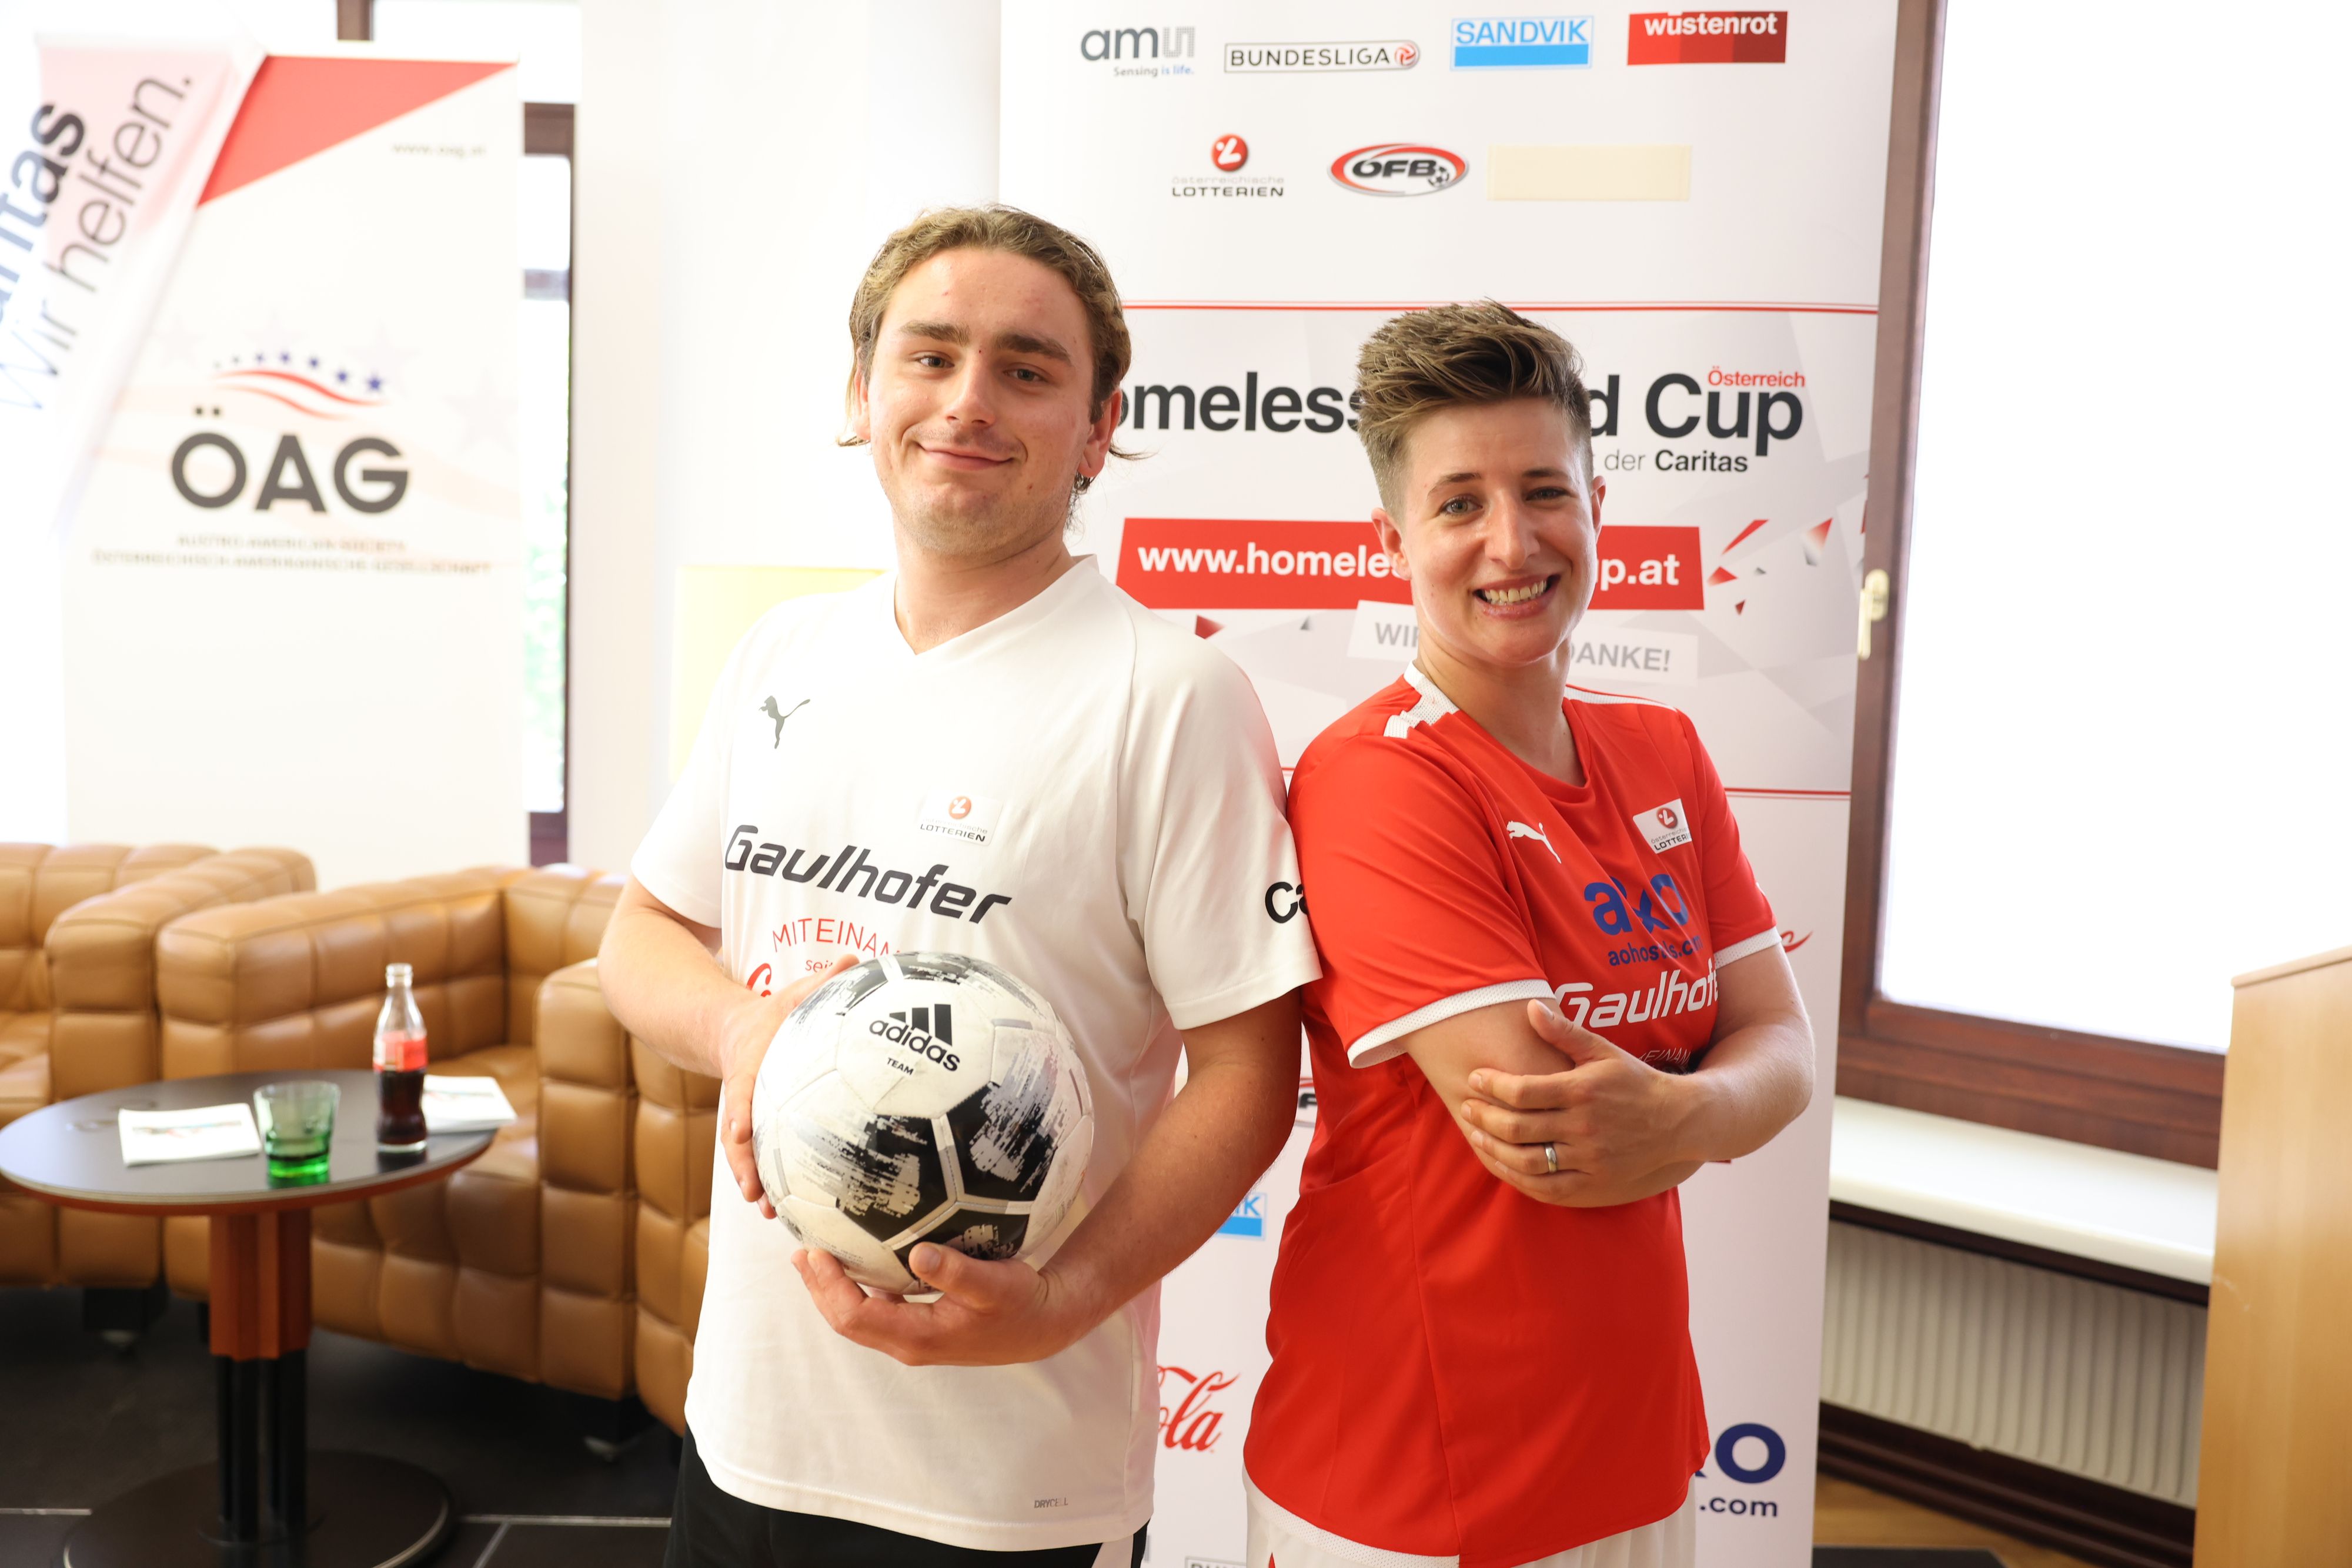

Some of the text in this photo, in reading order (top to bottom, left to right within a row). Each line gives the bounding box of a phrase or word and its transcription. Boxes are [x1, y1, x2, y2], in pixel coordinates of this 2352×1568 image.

[1455, 19, 1588, 45] SANDVIK
[1231, 48, 1390, 66] BUNDESLIGA
[1114, 66, 1158, 77] Sensing
[1162, 65, 1170, 75] is
[43, 74, 193, 293] helfen.
[1172, 186, 1284, 197] LOTTERIEN
[1708, 366, 1805, 389] Österreich
[1120, 372, 1362, 433] meles
[1646, 373, 1803, 456] Cup
[171, 406, 409, 514] ÖAG
[1605, 449, 1748, 473] der Caritas
[1137, 542, 1681, 591] www.homele p.at
[1571, 641, 1671, 672] ANKE!
[920, 824, 986, 842] LOTTERIEN
[725, 824, 1013, 924] Gaulhofer
[870, 1020, 960, 1072] adidas
[887, 1057, 914, 1075] TEAM
